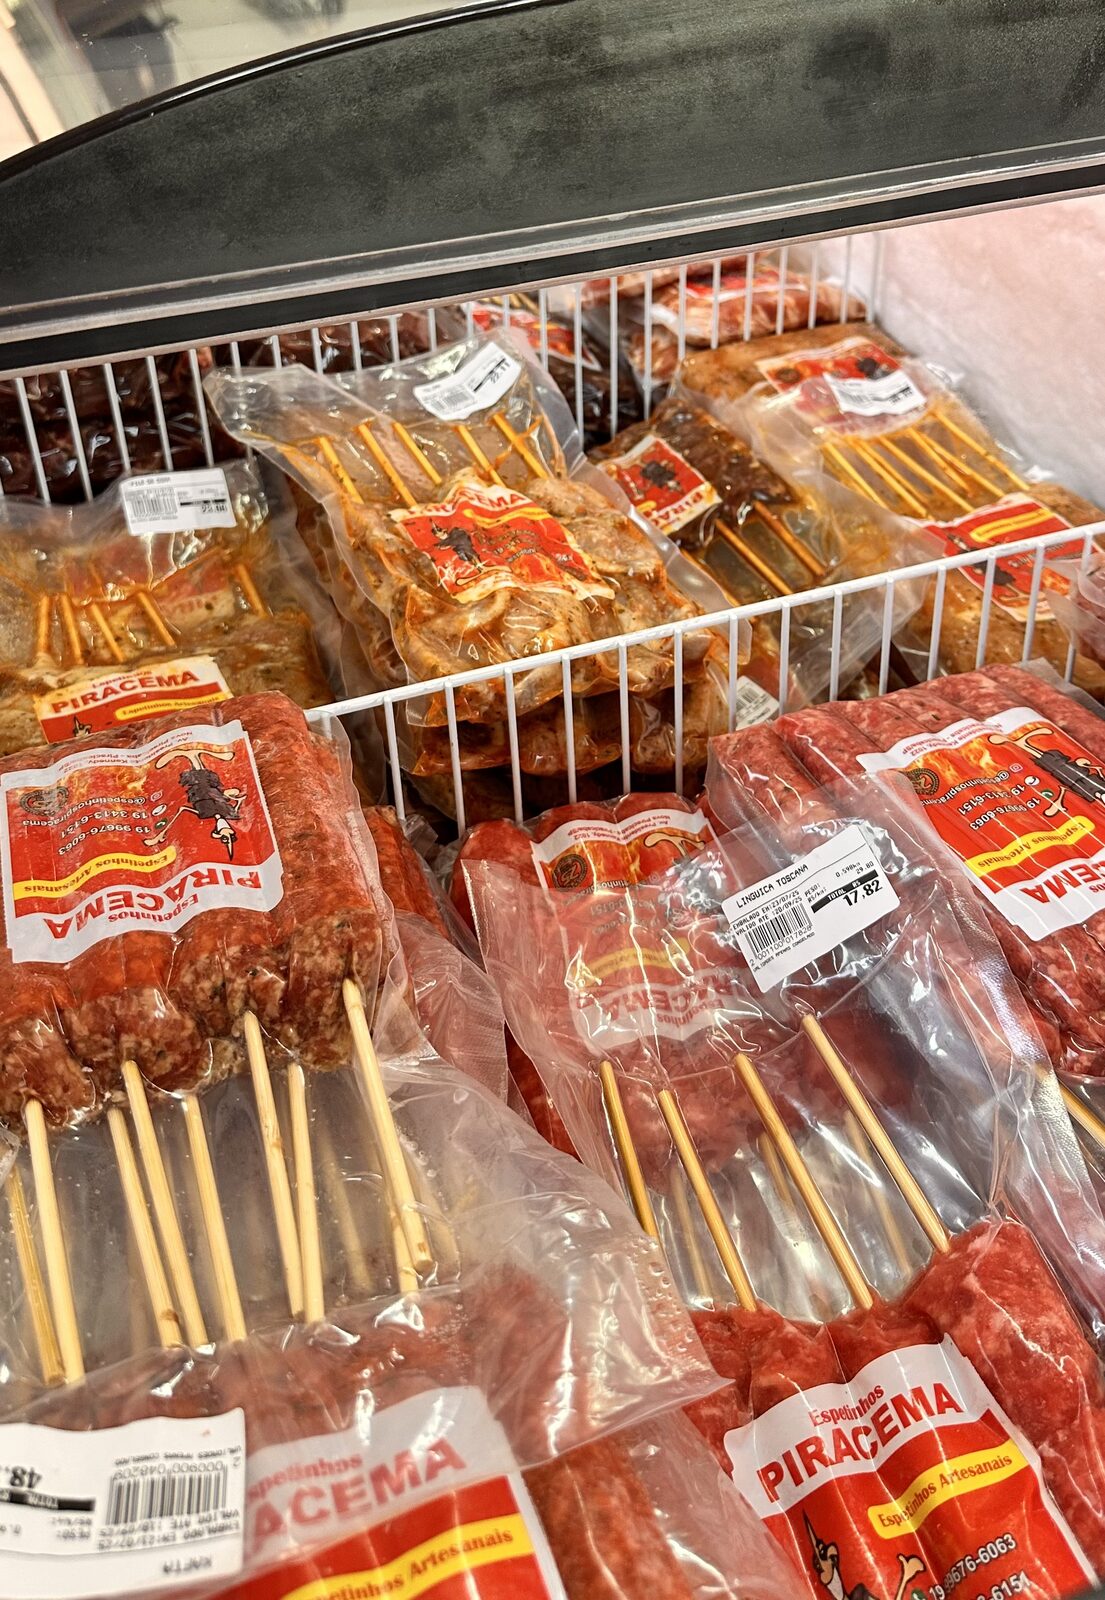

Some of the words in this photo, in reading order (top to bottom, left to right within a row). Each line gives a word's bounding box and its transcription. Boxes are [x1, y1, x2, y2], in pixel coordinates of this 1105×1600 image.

[51, 671, 200, 714] PIRACEMA
[1010, 784, 1025, 796] 19
[1027, 797, 1041, 809] 19
[22, 796, 146, 826] @espetinhospiracema
[61, 811, 129, 838] 3413-6151
[132, 811, 148, 819] 19
[58, 825, 131, 855] 99676-6063
[135, 826, 150, 834] 19
[95, 855, 168, 867] Espetinhos
[977, 842, 1031, 868] Artesanais
[24, 866, 91, 892] Artesanais
[735, 883, 775, 909] LINGUICA
[775, 863, 809, 887] TOSCANA
[43, 868, 262, 939] PIRACEMA
[108, 893, 198, 922] Espetinhos
[827, 888, 847, 901] TOTAL
[732, 911, 760, 930] EMBALADO
[736, 921, 757, 936] VALIDO
[758, 914, 769, 925] ATE
[757, 941, 784, 961] 001100
[808, 1384, 885, 1427] Espetinhos
[756, 1382, 965, 1504] PIRACEMA
[172, 1460, 224, 1473] 000900
[247, 1453, 363, 1498] spetinhos
[250, 1437, 466, 1554] ACEMA
[877, 1481, 937, 1527] Espetinhos
[939, 1453, 1013, 1488] Artesanais
[409, 1529, 514, 1580] Artesanais
[928, 1583, 946, 1600] 19
[943, 1533, 1018, 1593] 99676-6063
